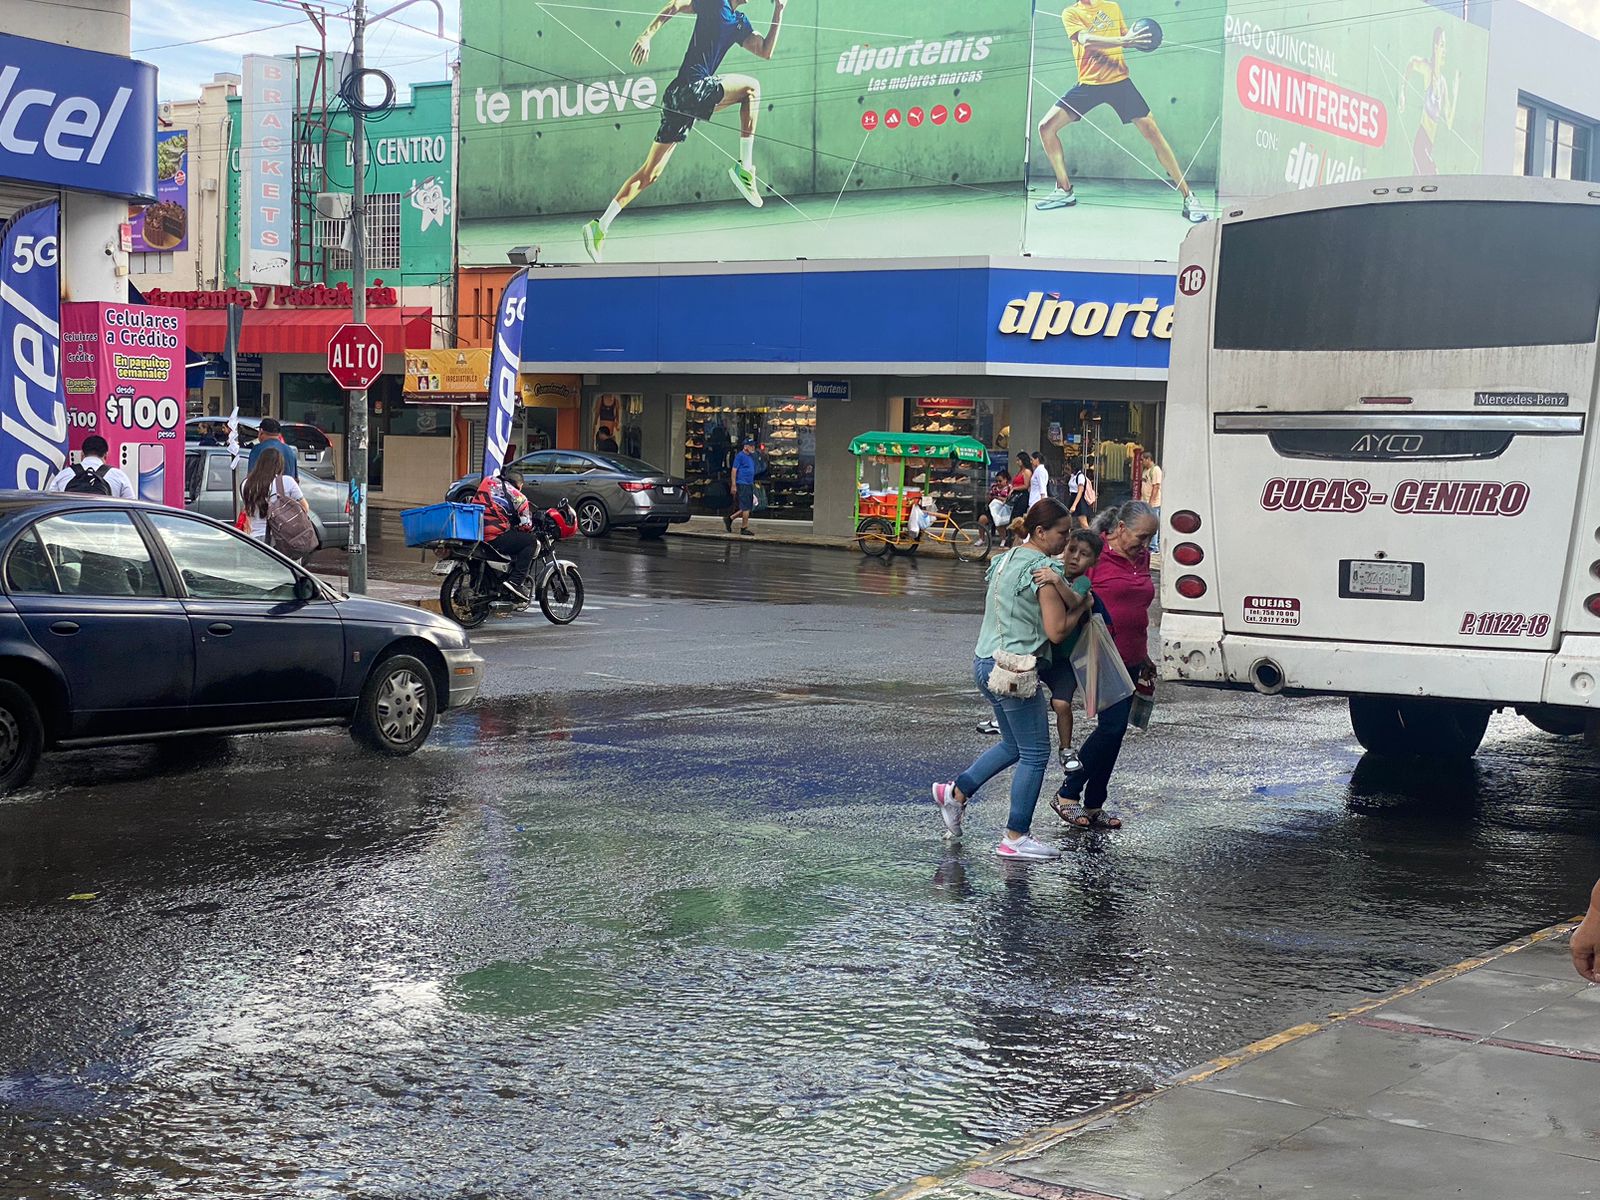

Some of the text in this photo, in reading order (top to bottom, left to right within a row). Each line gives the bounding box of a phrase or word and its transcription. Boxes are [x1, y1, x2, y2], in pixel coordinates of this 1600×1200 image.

[836, 36, 993, 76] dportenis
[1224, 15, 1338, 77] PAGO QUINCENAL
[867, 70, 983, 92] Las mejores marcas
[475, 76, 657, 124] te mueve
[1247, 64, 1380, 139] SIN INTERESES
[1255, 128, 1279, 151] CON:
[260, 64, 284, 247] BRACKETS
[345, 140, 371, 167] DL
[376, 135, 446, 166] CENTRO
[12, 235, 58, 274] 5G
[1182, 269, 1203, 292] 18
[105, 308, 178, 330] Celulares
[63, 332, 98, 342] Celulares
[78, 344, 84, 352] a
[106, 327, 177, 348] a Crédito
[67, 351, 95, 362] Crédito
[114, 354, 128, 367] En
[332, 343, 379, 369] ALTO
[118, 367, 168, 380] semanales
[116, 386, 135, 395] desde
[813, 383, 848, 394] dportenis
[1478, 394, 1565, 405] Mercedes-Benz
[106, 395, 179, 429] $100
[157, 431, 176, 440] pesos
[1350, 434, 1424, 452] AYCO
[1390, 479, 1530, 516] CENTRO
[1251, 598, 1292, 608] QUEJAS
